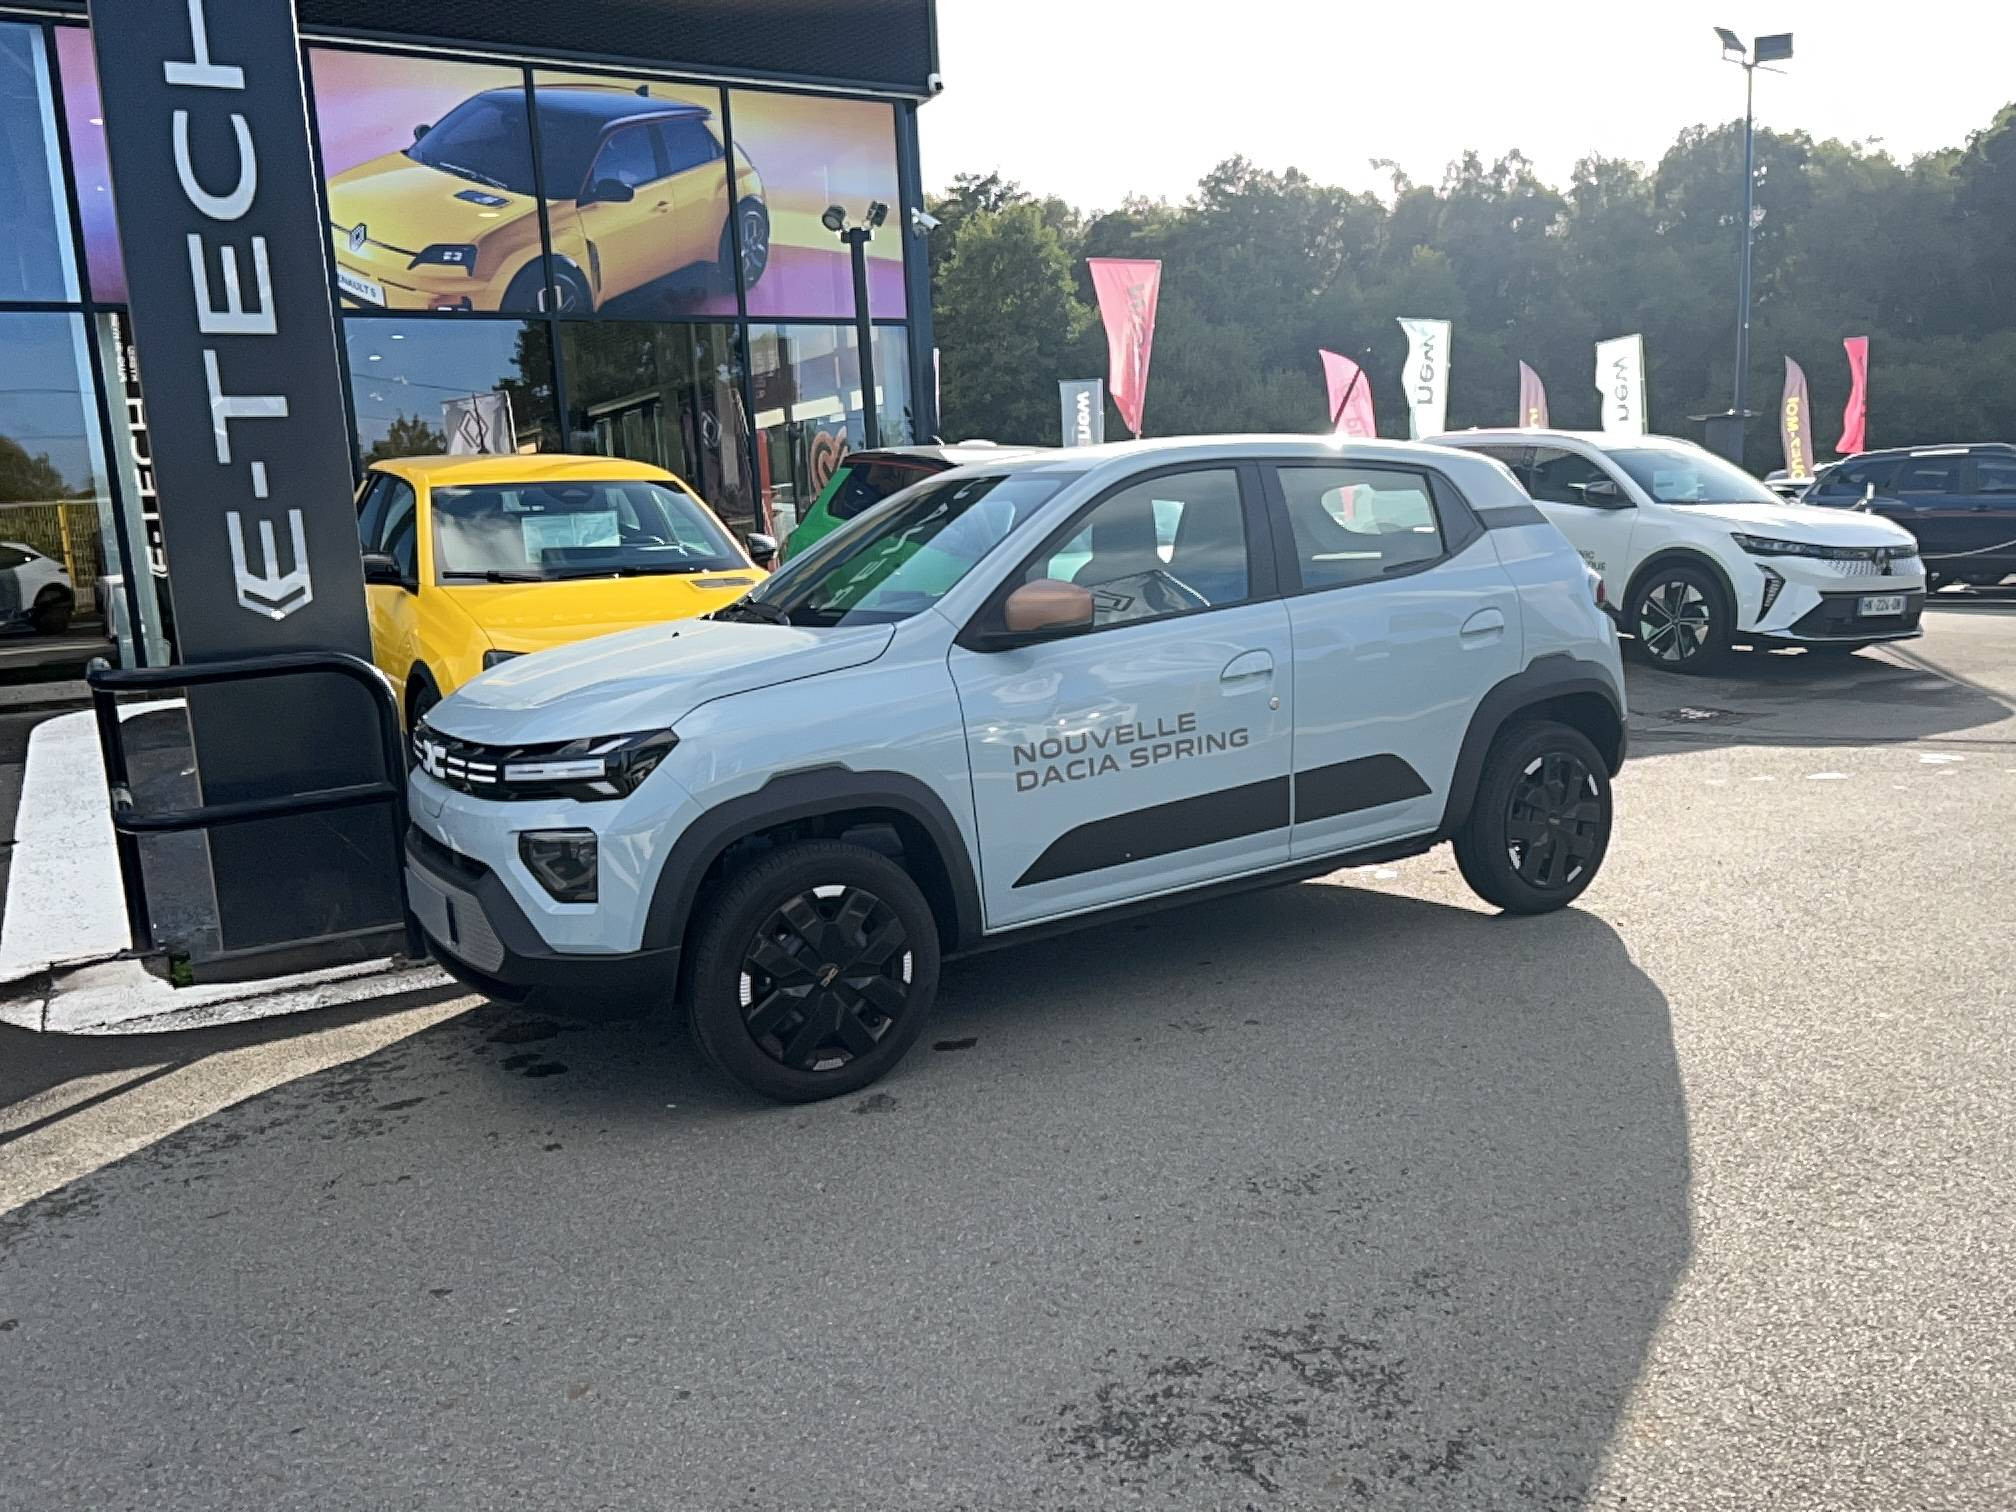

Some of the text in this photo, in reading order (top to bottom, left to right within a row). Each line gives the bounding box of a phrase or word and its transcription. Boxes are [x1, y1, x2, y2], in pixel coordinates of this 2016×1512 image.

[164, 0, 313, 620] E-TECH
[1013, 711, 1198, 767] NOUVELLE
[1016, 727, 1250, 793] DACIA SPRING
